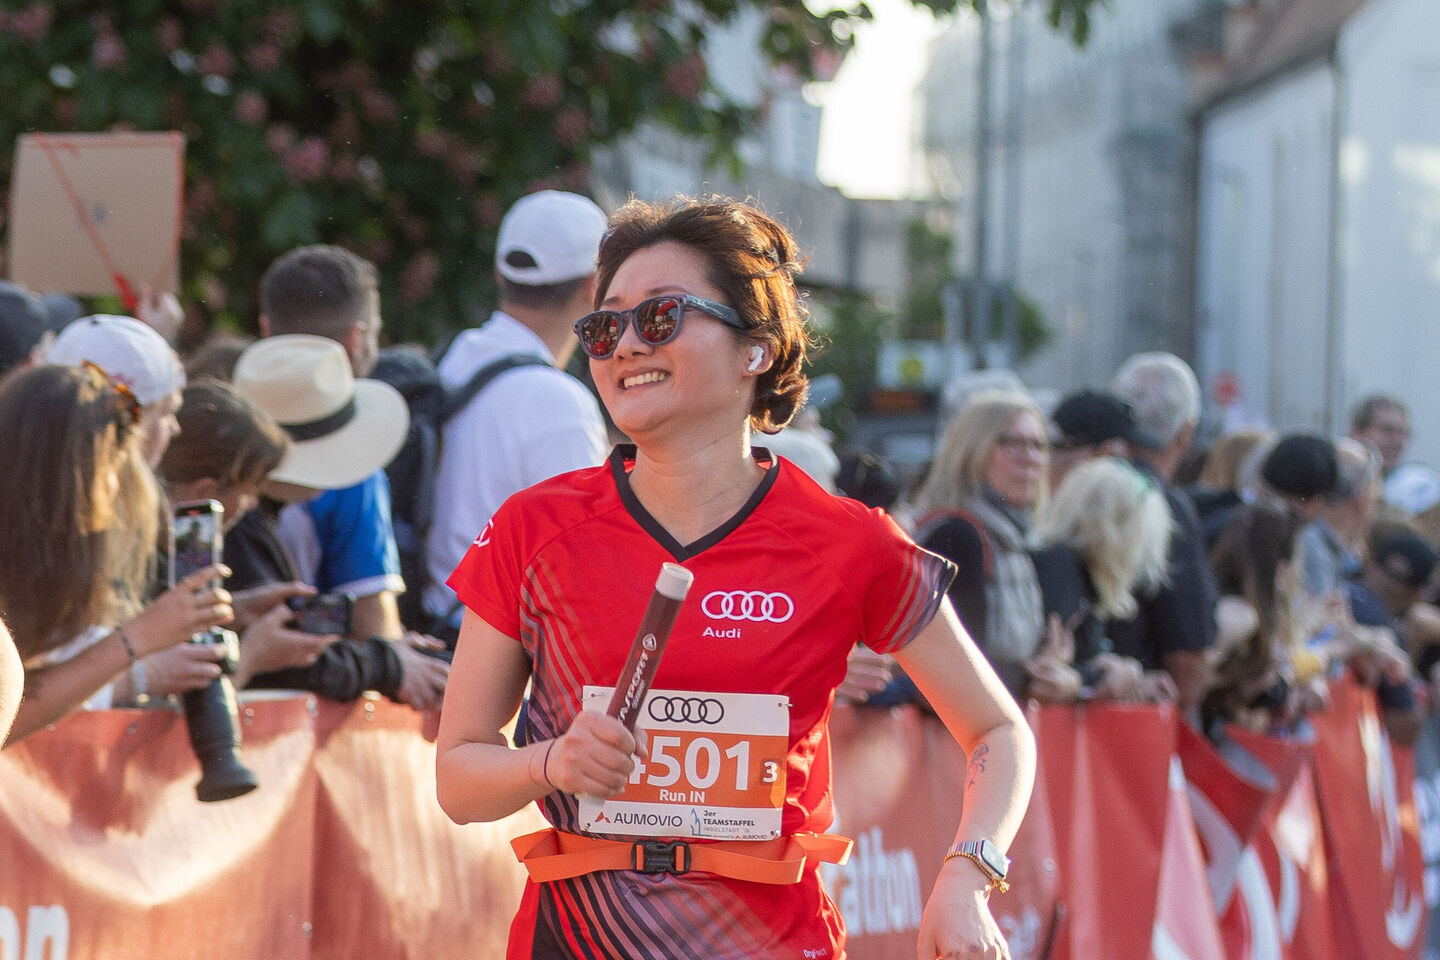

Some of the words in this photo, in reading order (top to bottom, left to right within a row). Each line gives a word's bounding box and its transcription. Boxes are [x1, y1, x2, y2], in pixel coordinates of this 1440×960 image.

[702, 626, 741, 639] Audi
[762, 761, 778, 783] 3
[659, 789, 686, 803] Run
[690, 791, 706, 804] IN
[613, 812, 683, 828] AUMOVIO
[703, 818, 755, 827] TEAMSTAFFEL
